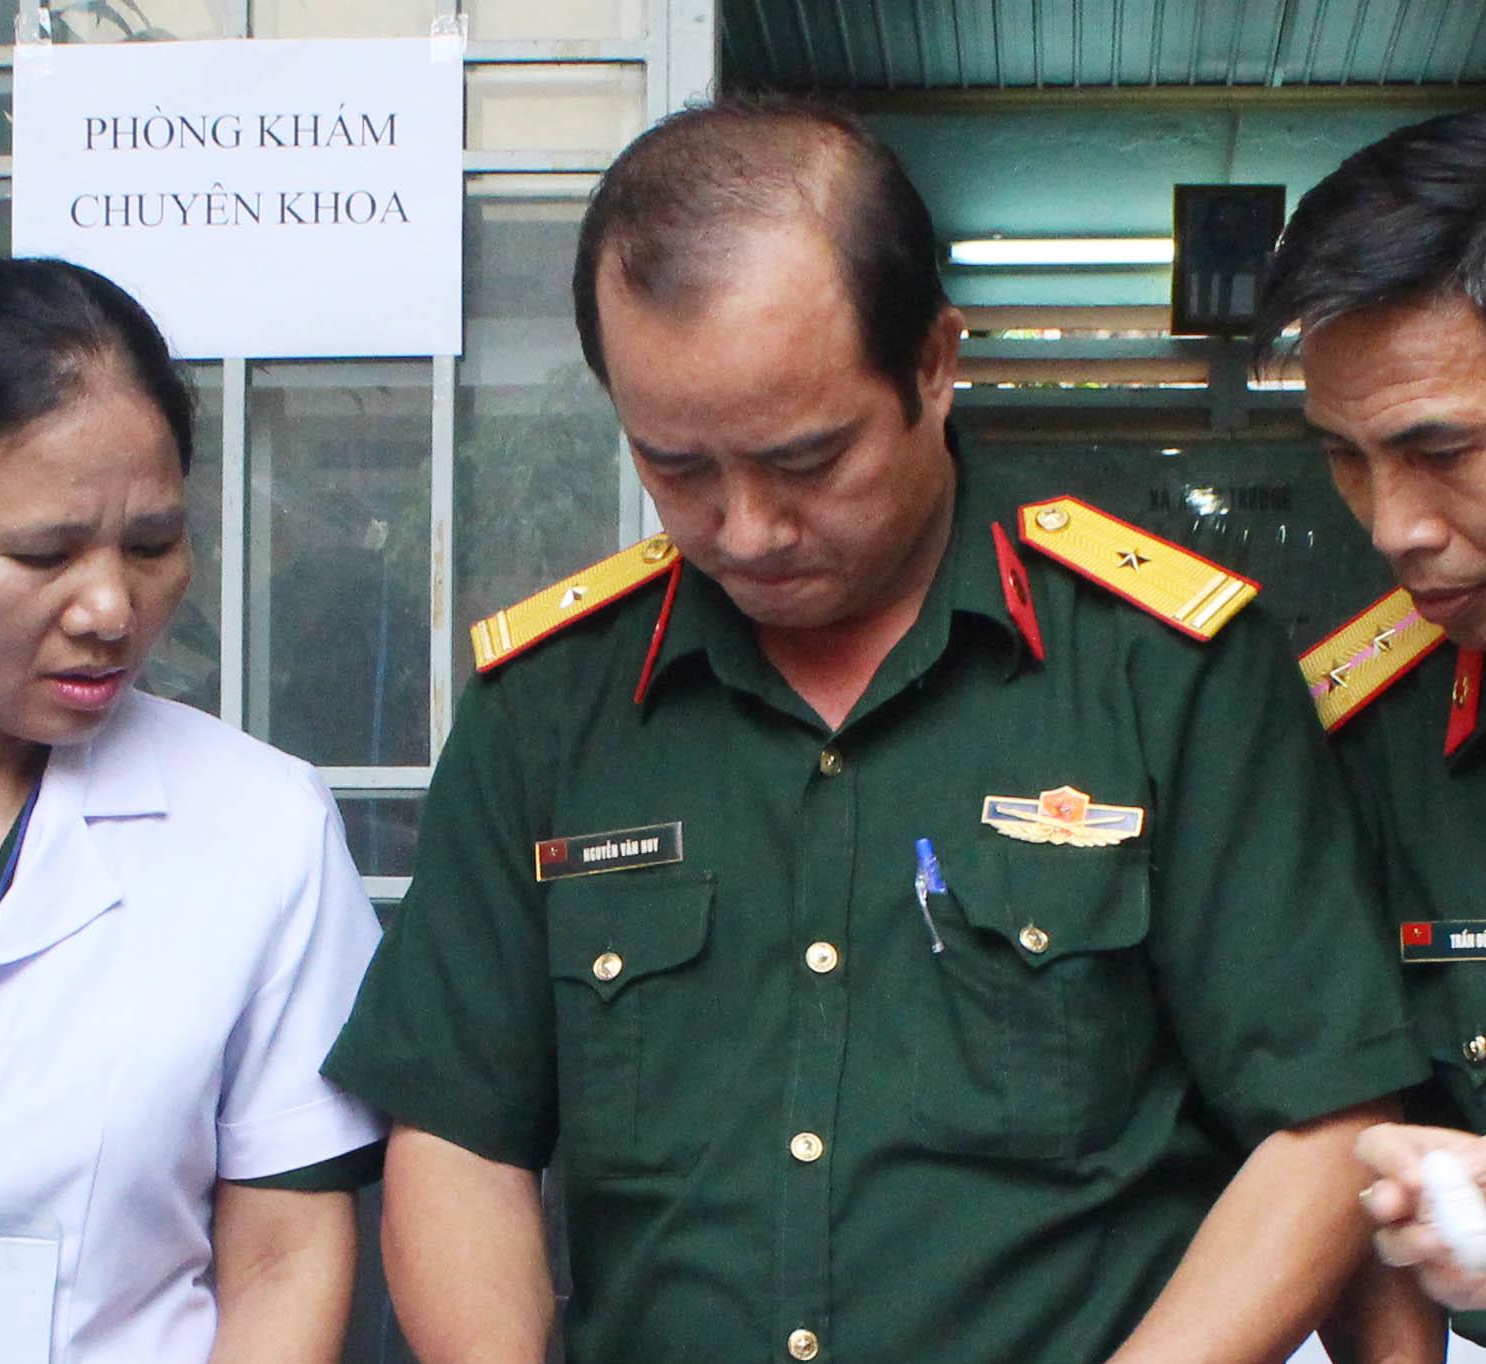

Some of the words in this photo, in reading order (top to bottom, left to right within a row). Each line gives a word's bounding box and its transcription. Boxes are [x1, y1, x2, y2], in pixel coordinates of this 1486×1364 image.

[84, 105, 242, 150] PHÒNG
[257, 103, 398, 148] KHÁM
[70, 182, 261, 228] CHUYÊN
[277, 190, 409, 225] KHOA
